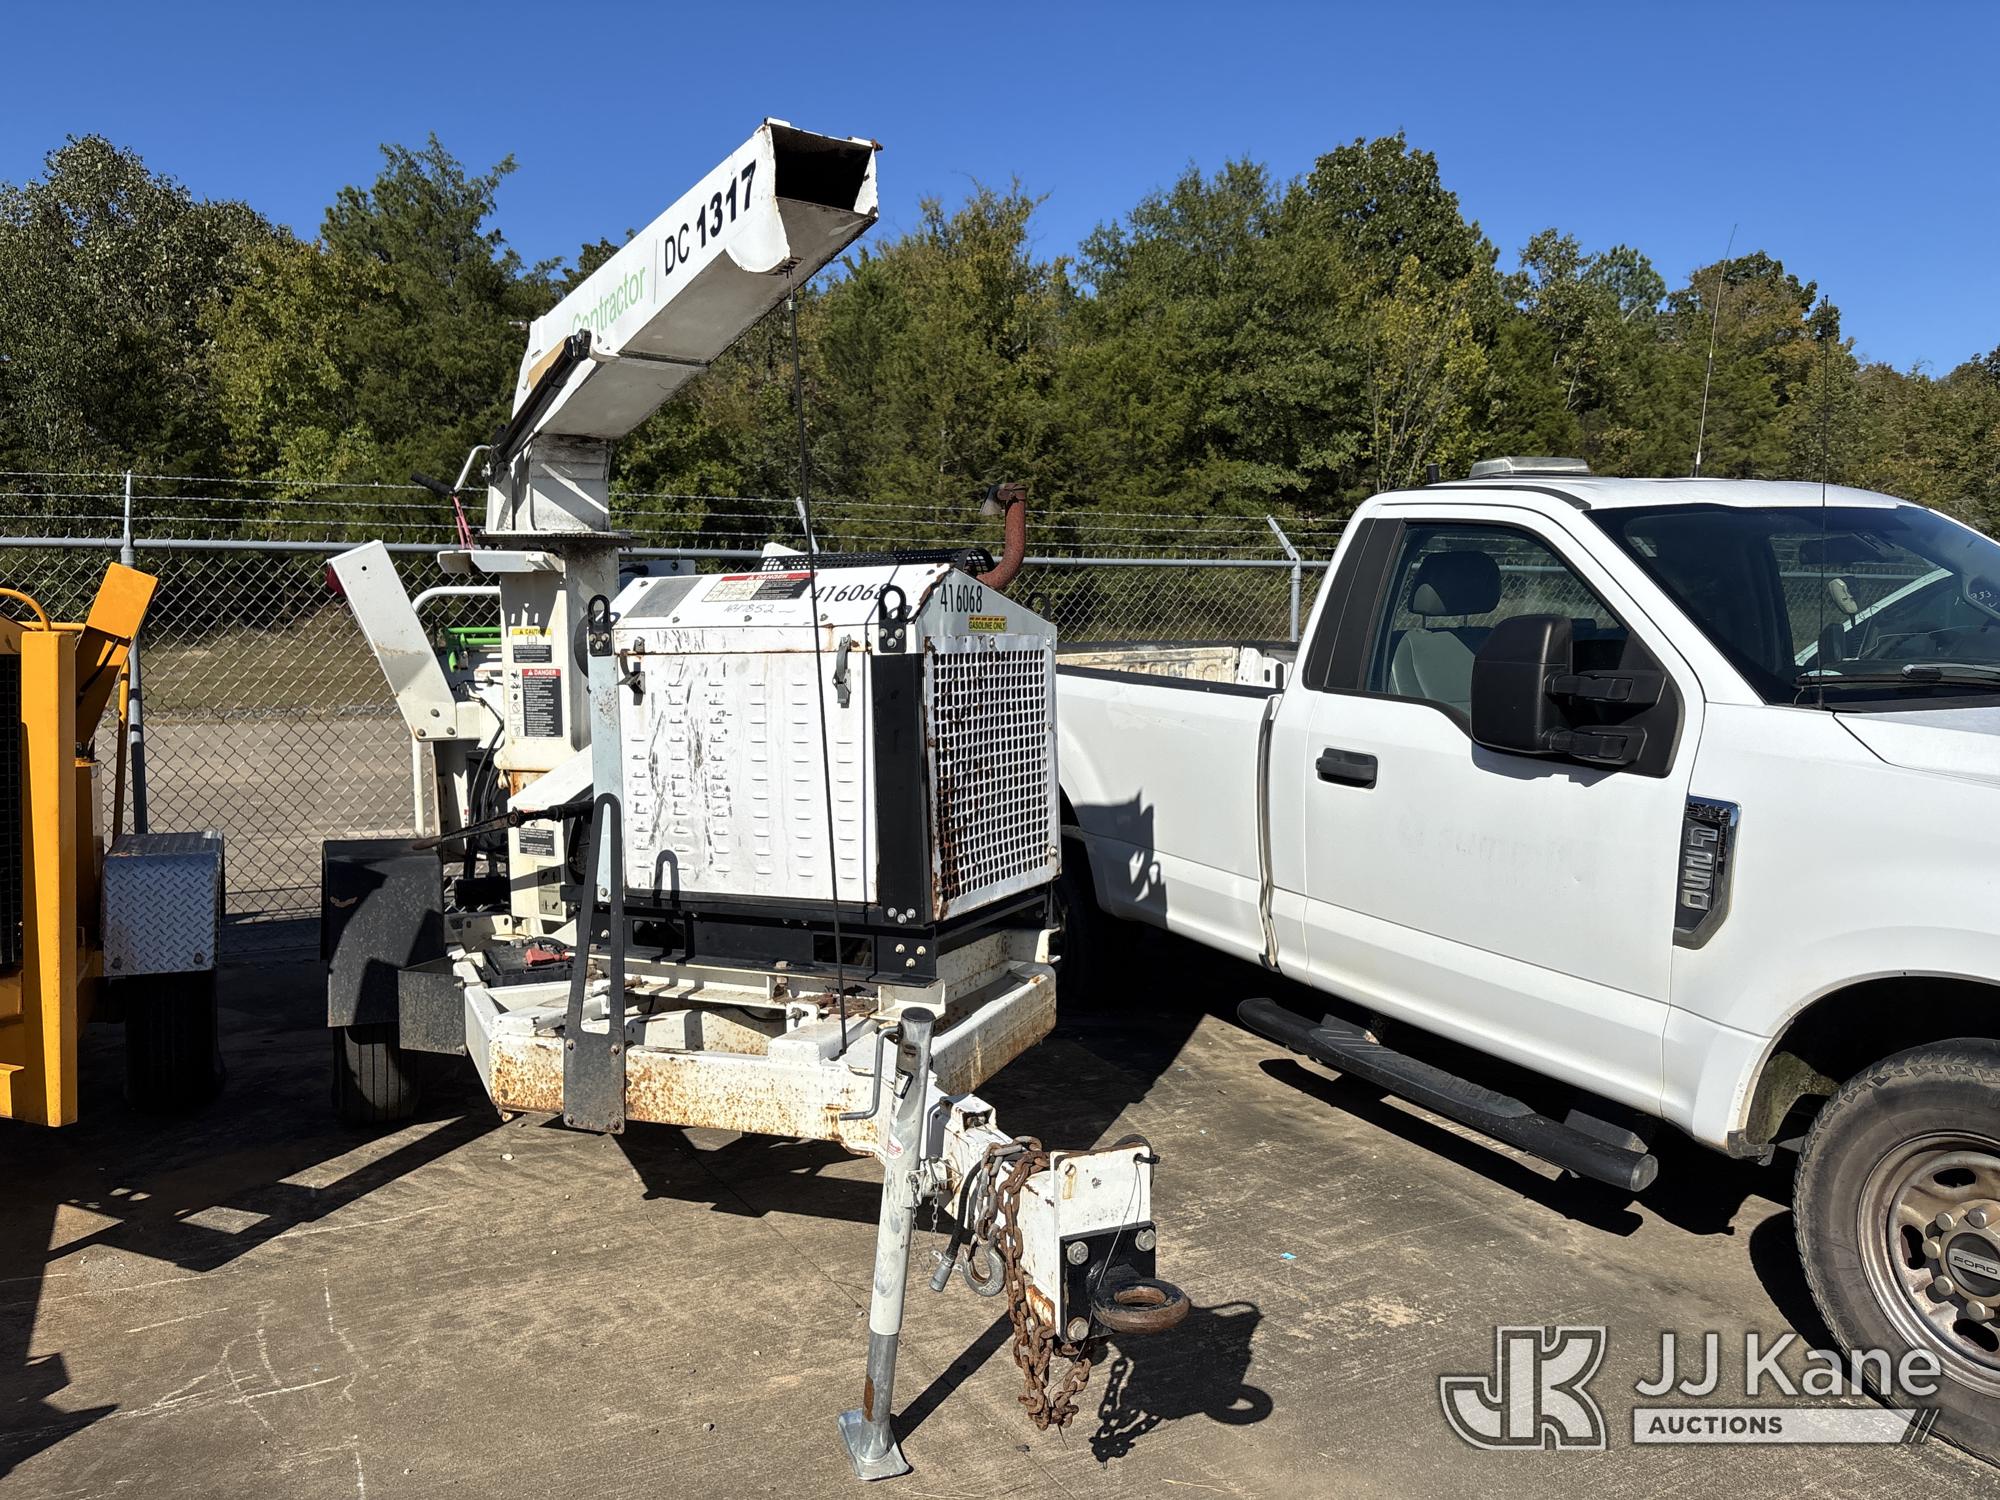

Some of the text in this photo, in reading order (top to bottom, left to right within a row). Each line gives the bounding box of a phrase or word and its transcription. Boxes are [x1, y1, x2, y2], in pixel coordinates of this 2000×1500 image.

[664, 222, 691, 277] DC
[696, 158, 757, 249] 1317
[940, 583, 983, 613] 416068
[968, 620, 1006, 630] GASOLINE ONLY
[1953, 1255, 1998, 1275] FORD
